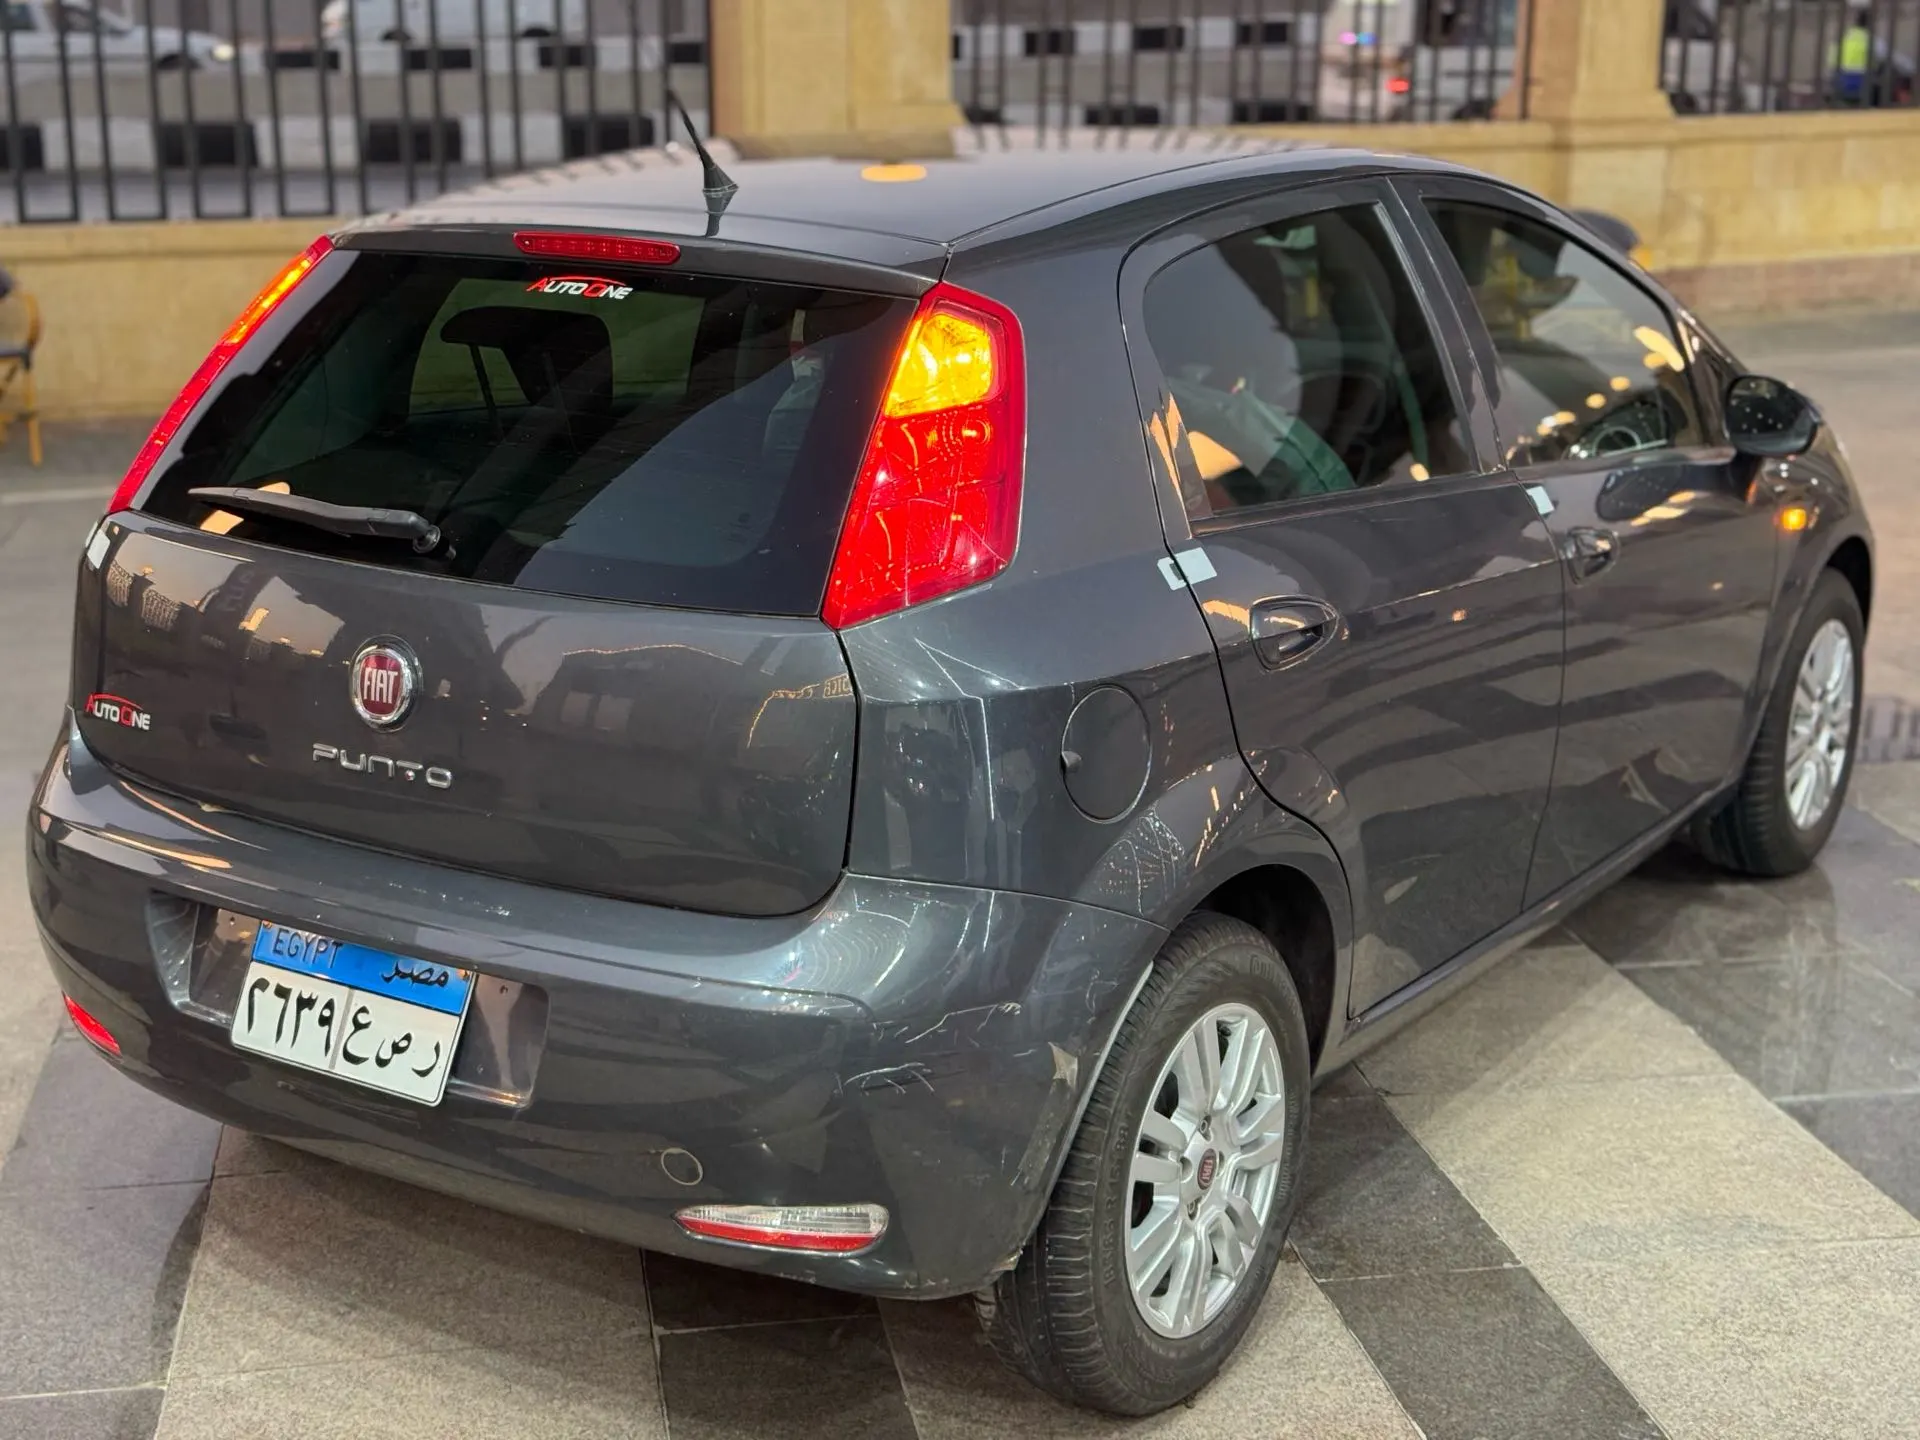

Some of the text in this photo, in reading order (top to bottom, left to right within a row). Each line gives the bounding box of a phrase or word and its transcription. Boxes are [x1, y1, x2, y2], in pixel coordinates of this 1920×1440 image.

[363, 667, 399, 704] FIAT
[312, 743, 453, 789] PUNTO
[272, 927, 343, 969] EGYPT
[380, 957, 450, 989] مصر
[247, 976, 336, 1058] ٢٦٣٩
